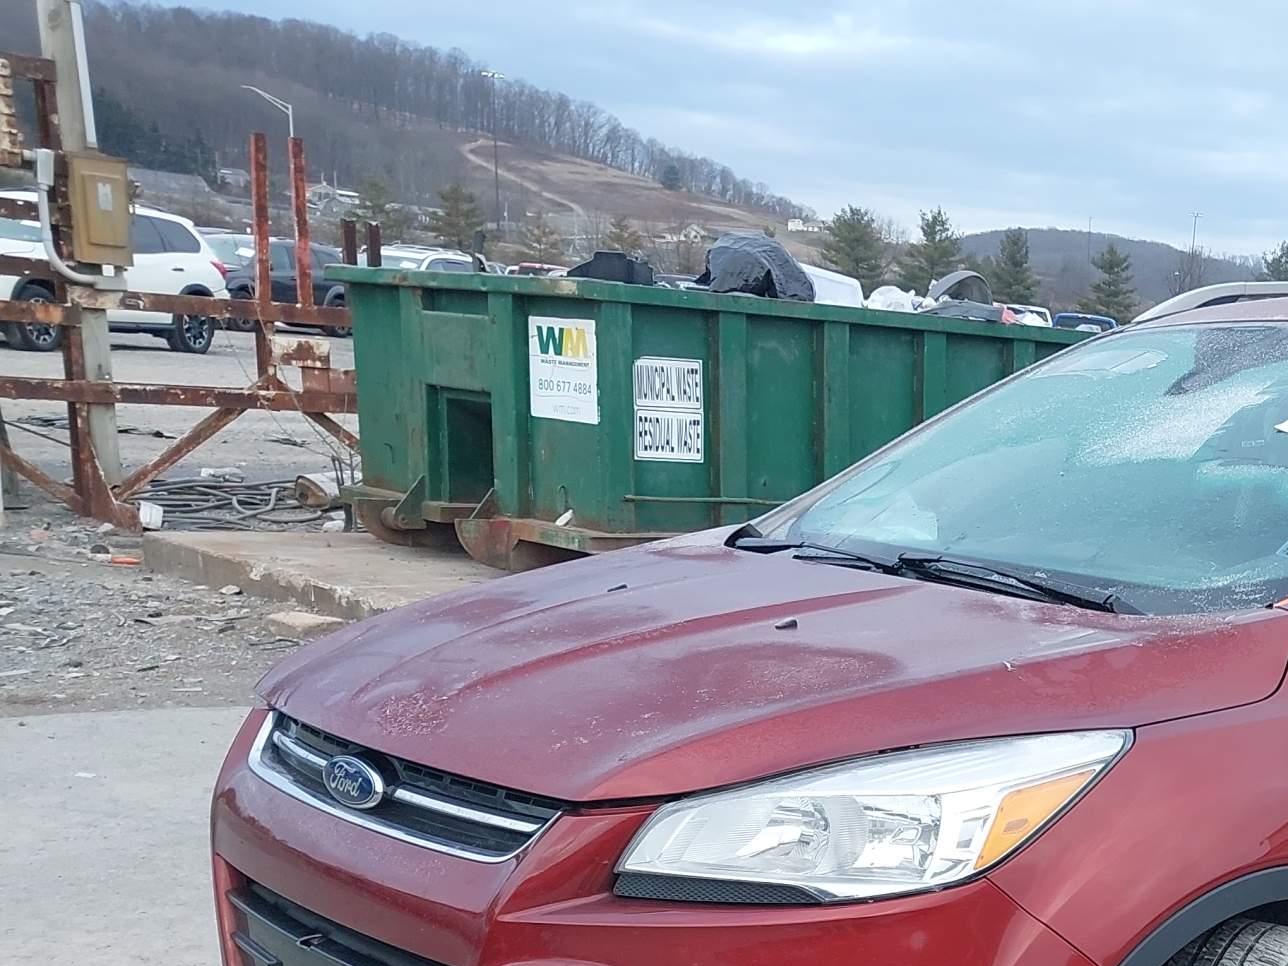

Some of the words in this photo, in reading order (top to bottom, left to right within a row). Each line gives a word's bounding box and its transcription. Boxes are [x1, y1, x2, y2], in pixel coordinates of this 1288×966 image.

[536, 325, 588, 358] WM
[538, 378, 555, 391] 800
[556, 380, 571, 393] 677
[573, 382, 592, 395] 4884
[636, 365, 675, 401] MUNICIPAL
[676, 367, 699, 403] WASTE
[639, 416, 675, 453] RESIDUAL
[676, 418, 700, 454] WASTE
[329, 762, 362, 797] Ford
